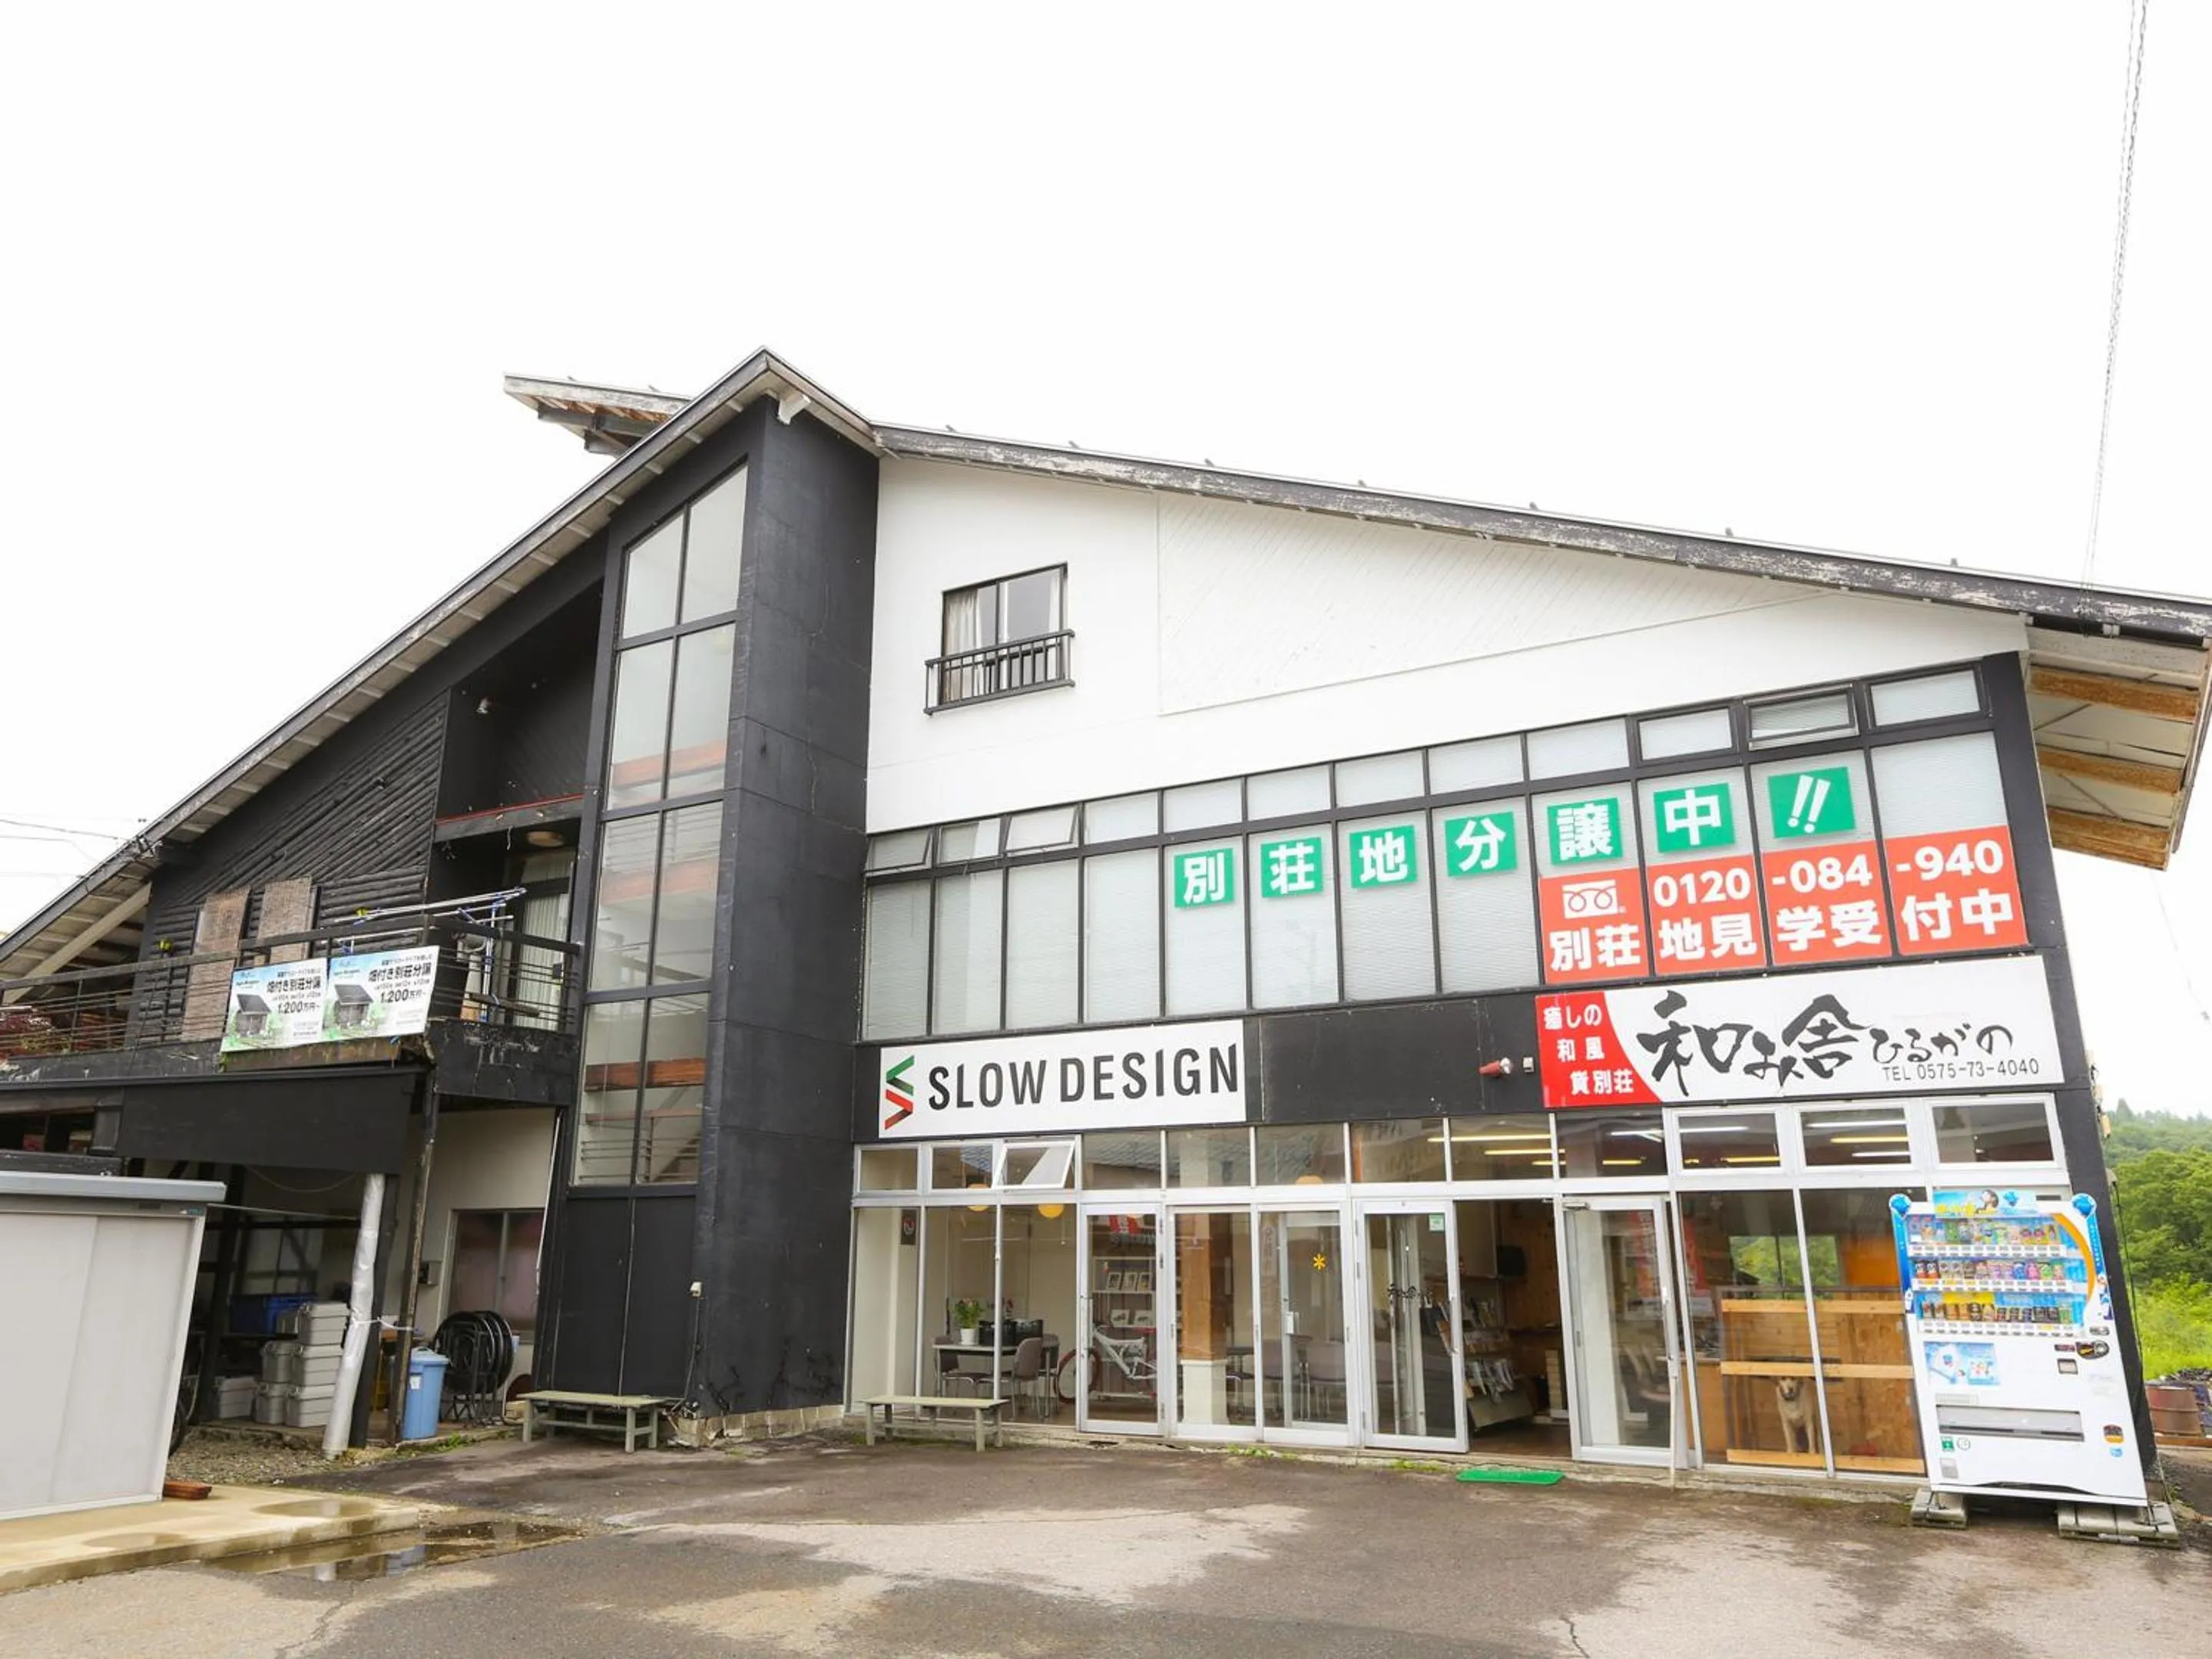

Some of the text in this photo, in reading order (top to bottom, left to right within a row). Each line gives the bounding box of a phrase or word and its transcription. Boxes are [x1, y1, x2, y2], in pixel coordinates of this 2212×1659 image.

[1543, 1004, 1602, 1030] 癒しの
[1557, 1036, 1605, 1062] 和風
[1869, 1022, 2013, 1063] ひるがの
[928, 1043, 1239, 1111] SLOW DESIGN
[1570, 1068, 1634, 1095] 貸別荘
[1882, 1058, 2039, 1082] TEL 0575-73-4040
